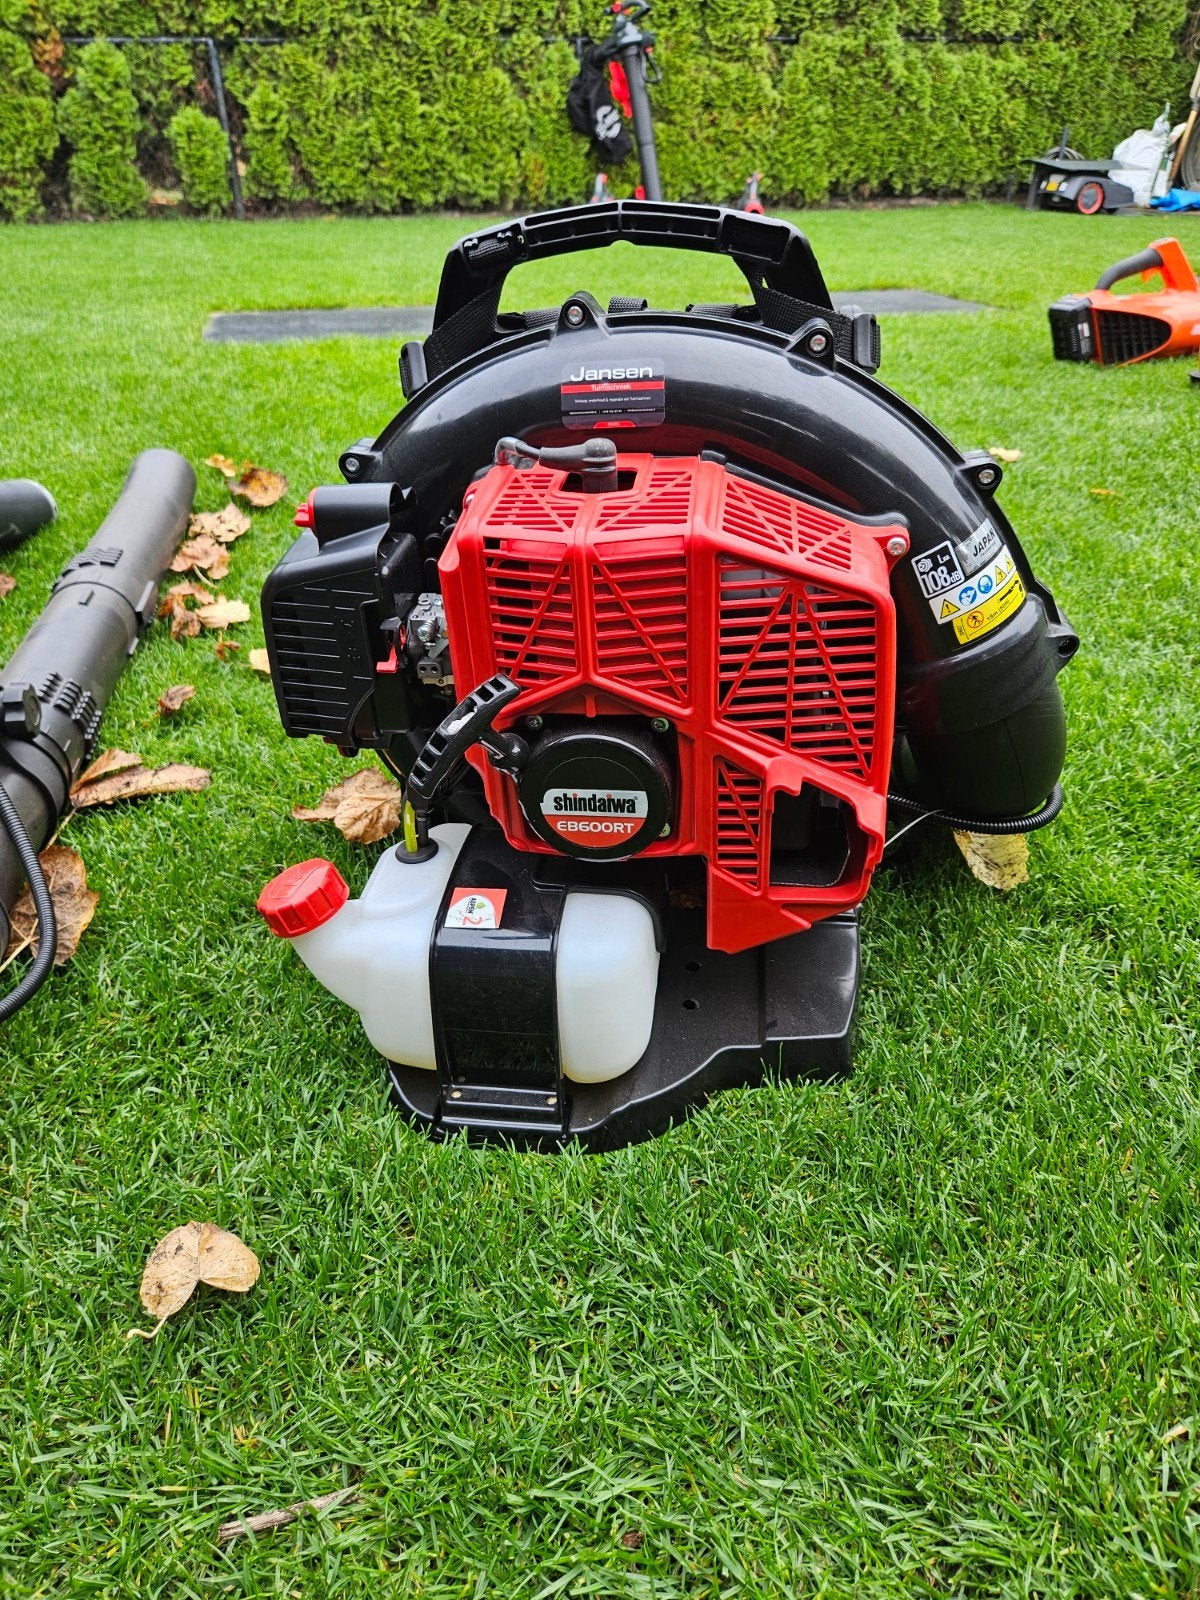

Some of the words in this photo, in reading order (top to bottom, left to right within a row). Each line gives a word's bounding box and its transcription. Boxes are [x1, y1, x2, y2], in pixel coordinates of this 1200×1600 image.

[570, 366, 653, 382] Jansen
[973, 529, 996, 557] JAPAN
[553, 793, 637, 813] shindaiwa
[557, 821, 635, 834] EB600RT
